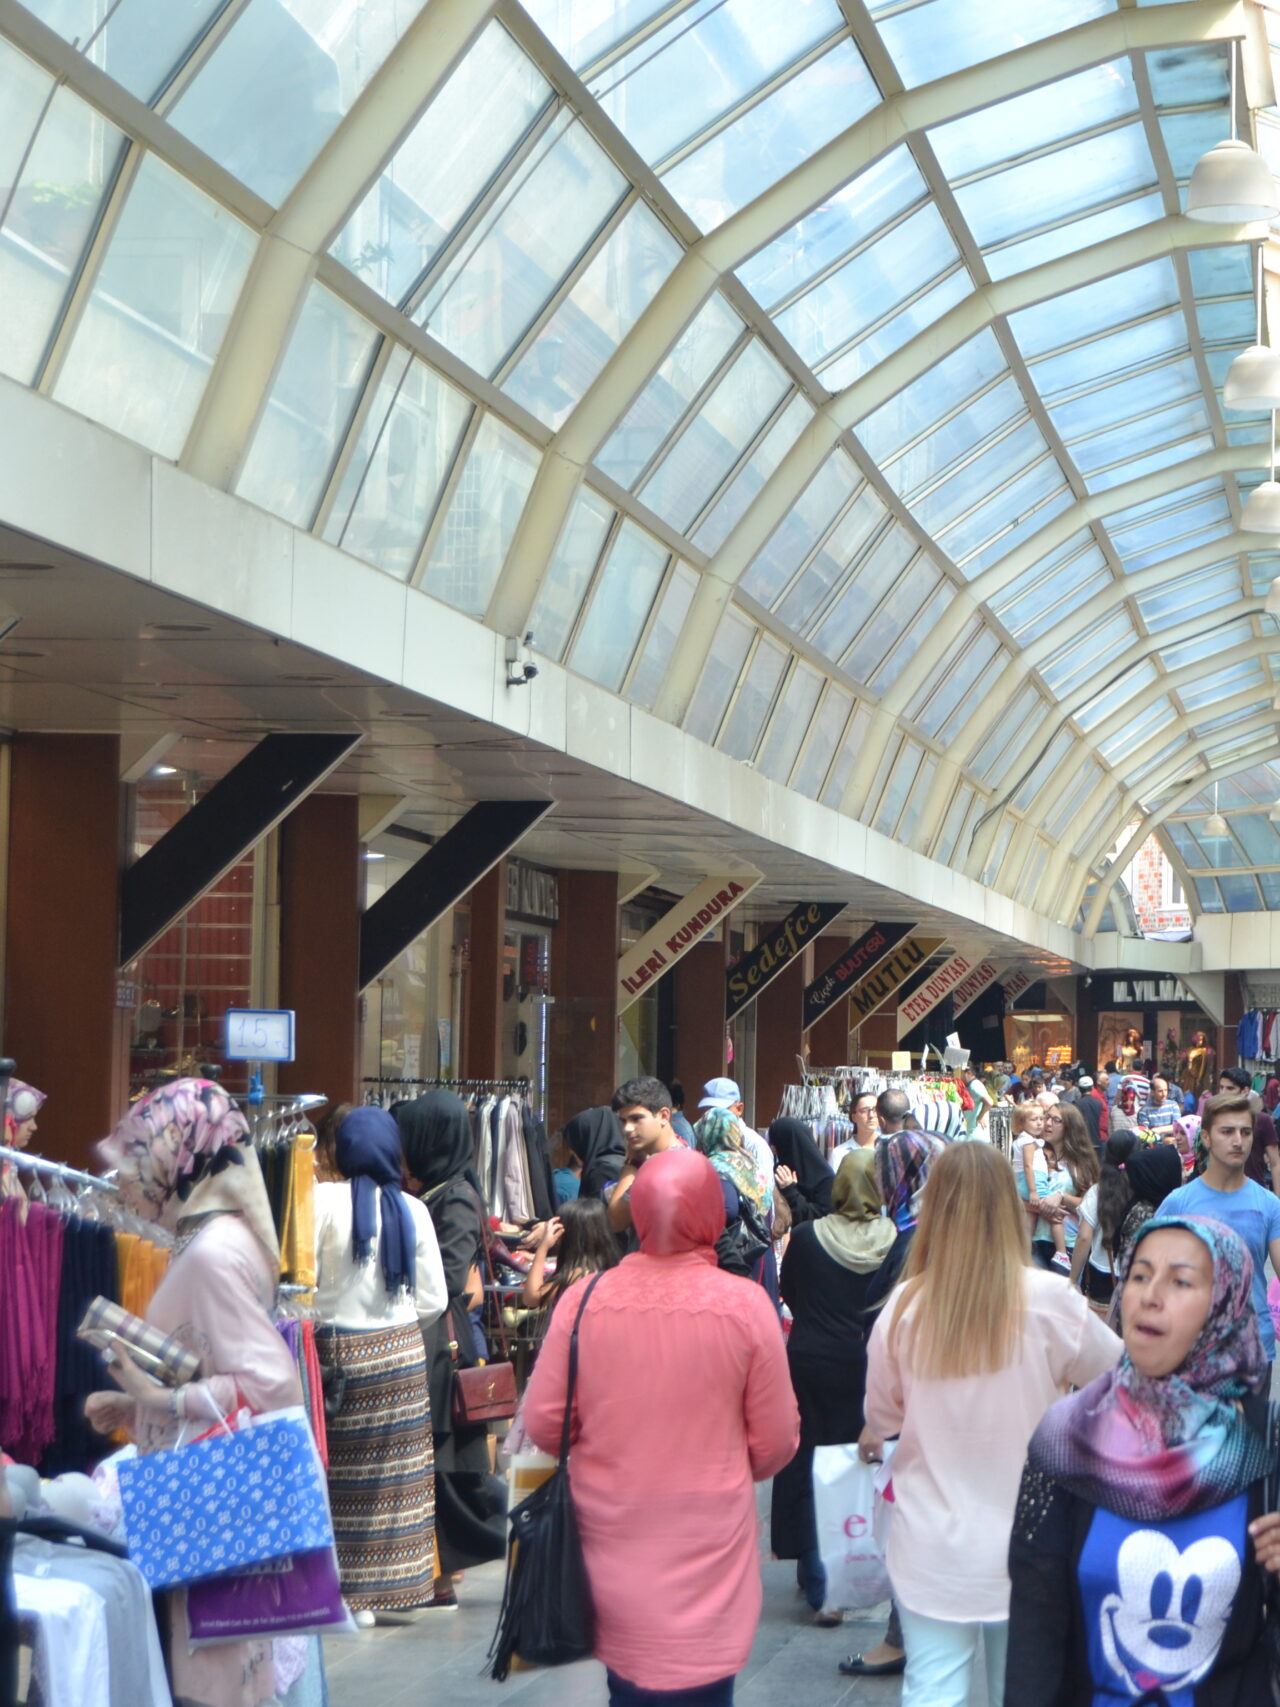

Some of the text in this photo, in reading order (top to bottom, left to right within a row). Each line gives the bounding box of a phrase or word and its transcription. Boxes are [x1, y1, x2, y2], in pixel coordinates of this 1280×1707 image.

[665, 881, 744, 954] KUNDURA
[852, 939, 925, 1016] MUTLU
[237, 1017, 268, 1048] 15
[901, 992, 933, 1023] ETEK
